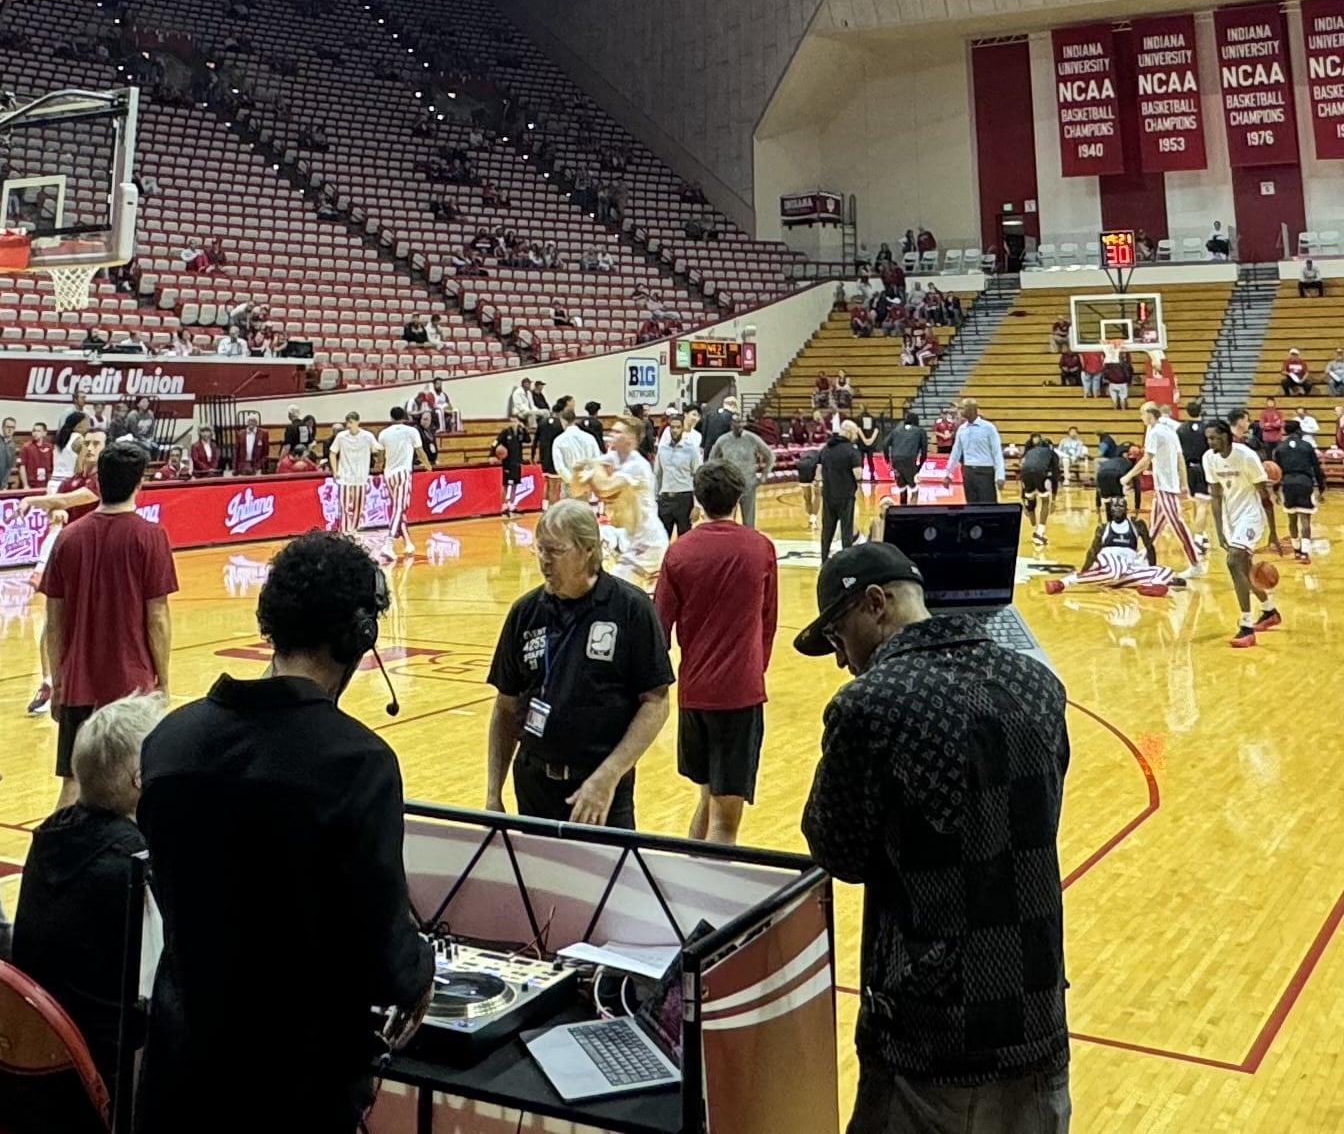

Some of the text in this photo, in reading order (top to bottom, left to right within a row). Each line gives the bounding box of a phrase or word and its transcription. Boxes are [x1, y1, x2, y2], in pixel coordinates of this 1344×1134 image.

[1226, 24, 1272, 41] INDIANA
[1062, 42, 1104, 59] INDIANA
[1143, 34, 1186, 50] INDIANA
[1221, 40, 1280, 60] UNIVERSITY
[1058, 58, 1110, 76] UNIVERSITY
[1138, 50, 1192, 67] UNIVERSITY
[1138, 70, 1198, 95] NCAA
[1222, 62, 1285, 89] NCAA
[1058, 78, 1115, 103] NCAA
[1141, 97, 1197, 115] BASKETBALL
[1225, 91, 1285, 109] BASKETBALL
[1060, 106, 1115, 123] BASKETBALL
[1229, 108, 1285, 126] CHAMPIONS
[1064, 122, 1114, 139] CHAMPIONS
[1144, 115, 1197, 133] CHAMPIONS
[1158, 137, 1185, 153] 1953
[1246, 130, 1275, 146] 1976
[1078, 142, 1104, 158] 1940
[1106, 245, 1131, 264] 30
[27, 366, 185, 395] IU Credit Union
[427, 474, 463, 514] Indiana
[225, 488, 276, 534] Indiana
